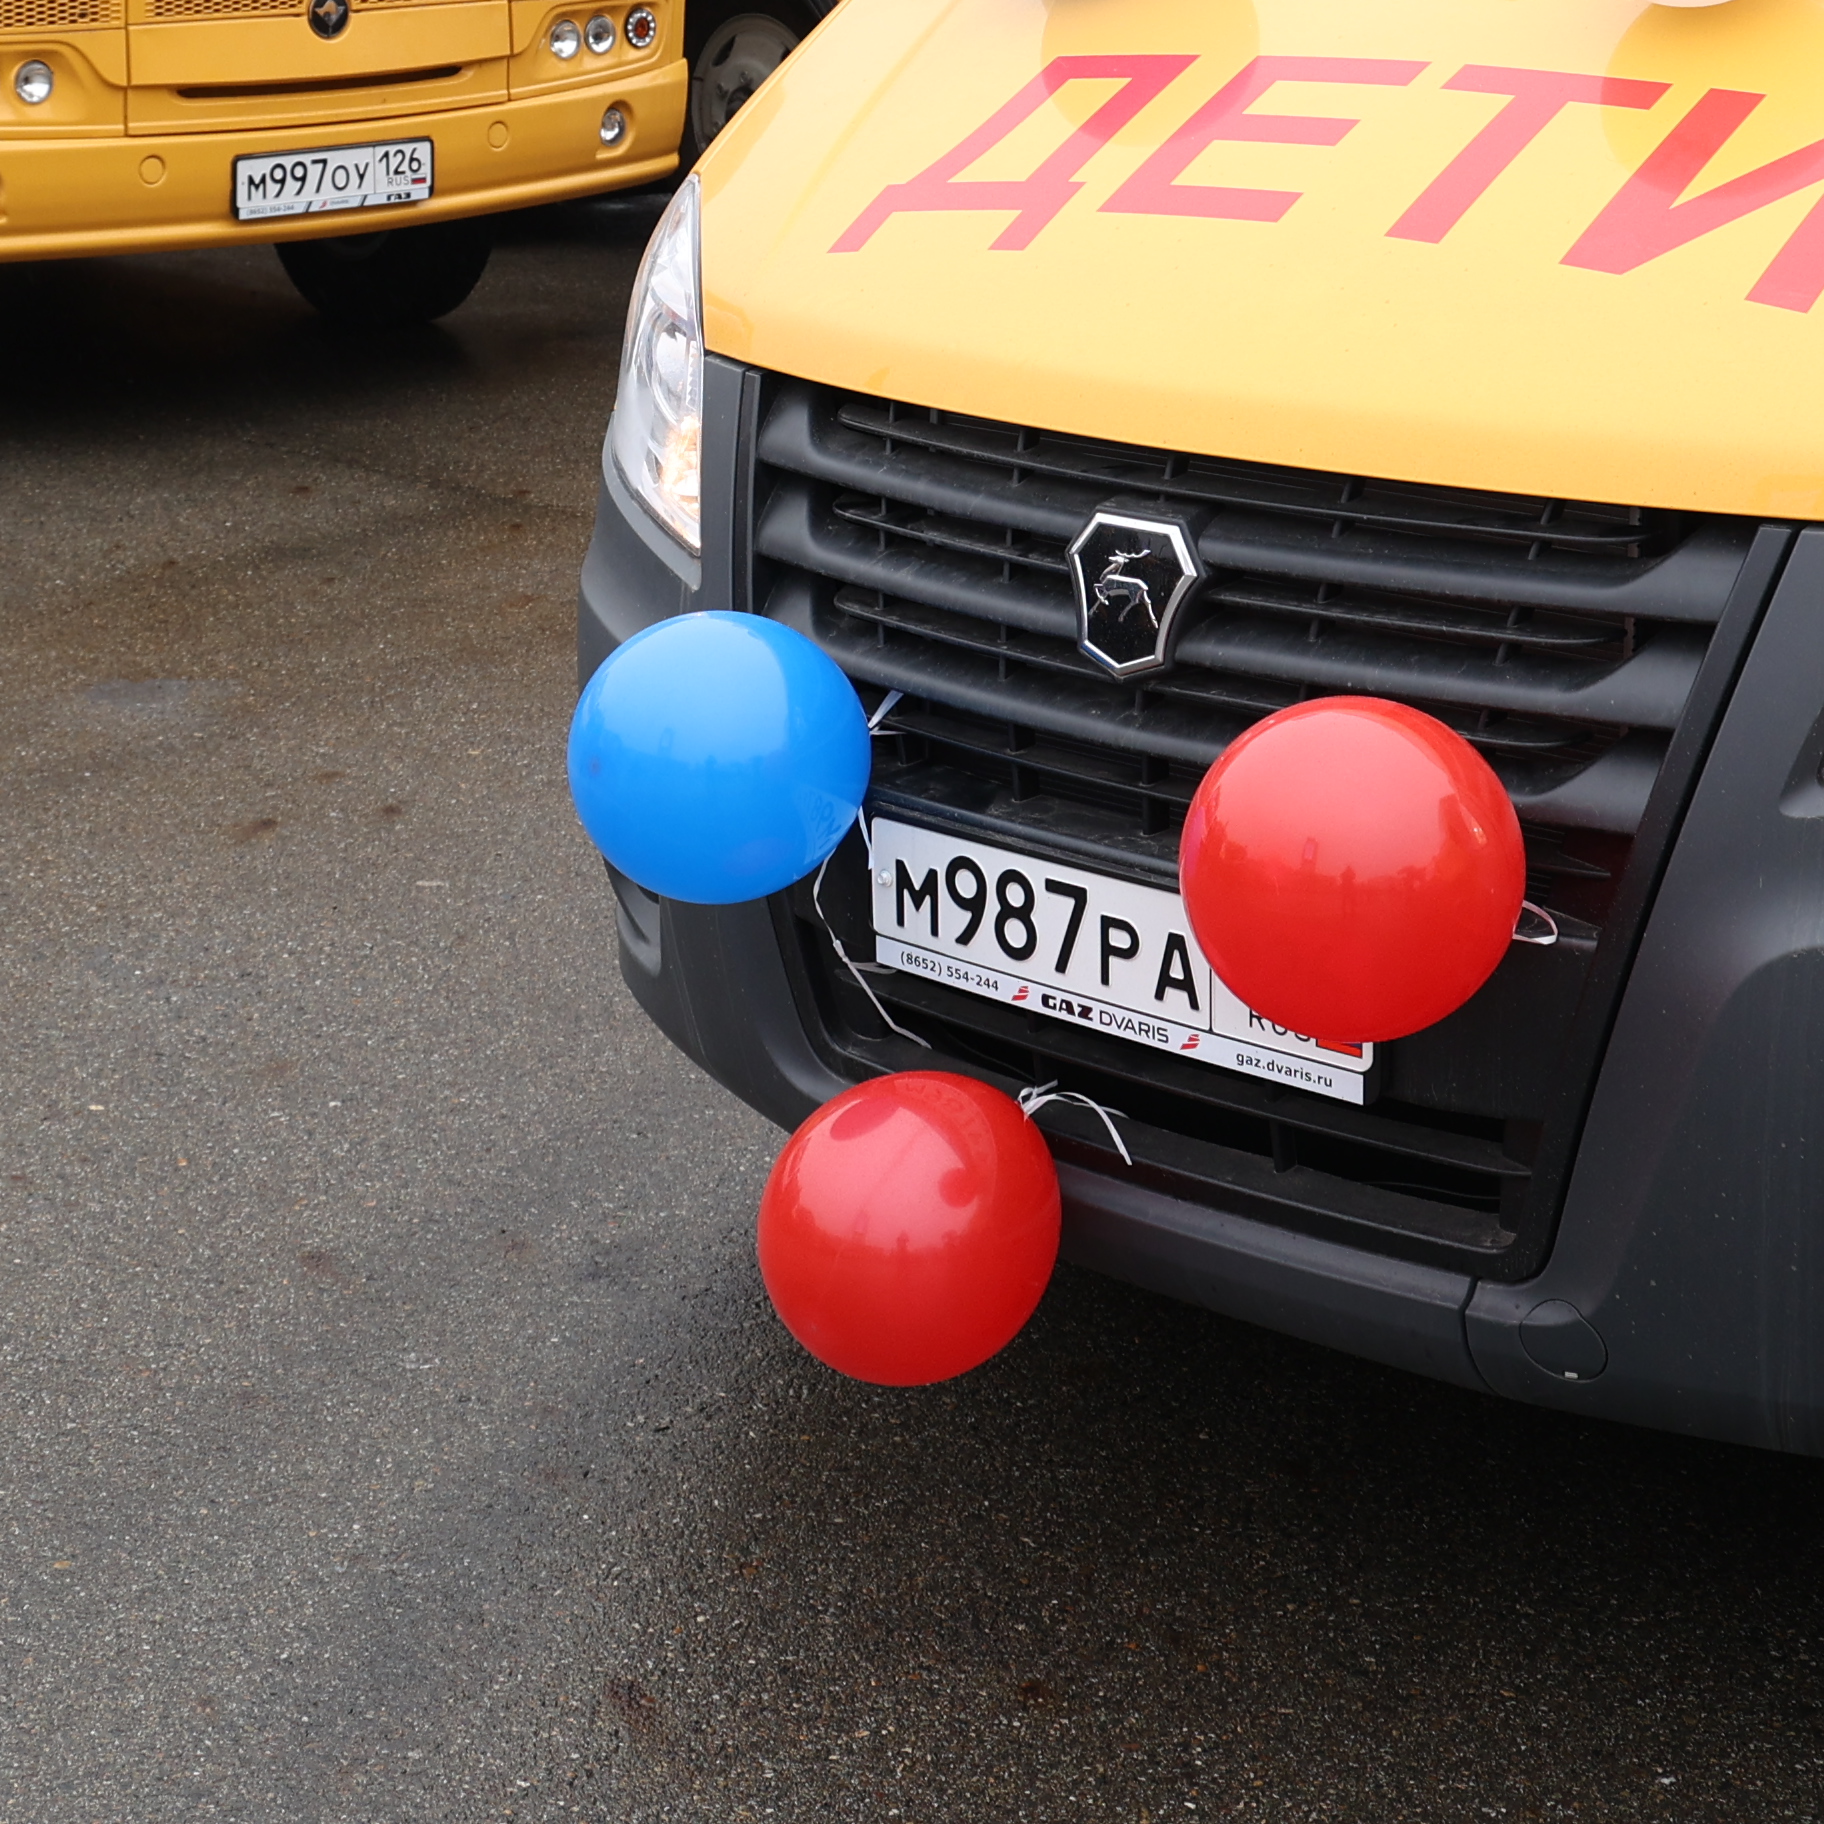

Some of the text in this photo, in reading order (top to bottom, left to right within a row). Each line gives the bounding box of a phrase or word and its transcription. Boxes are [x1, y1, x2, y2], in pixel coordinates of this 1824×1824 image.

[247, 147, 423, 202] М997ОУ 126
[386, 192, 412, 201] ГАЗ
[387, 175, 410, 187] RUS
[894, 855, 1201, 1012] М987РА
[900, 949, 1001, 994] (8652) 554-244
[1040, 993, 1171, 1045] GAZ DVARIS
[1234, 1049, 1335, 1090] gaz.dvaris.ru
